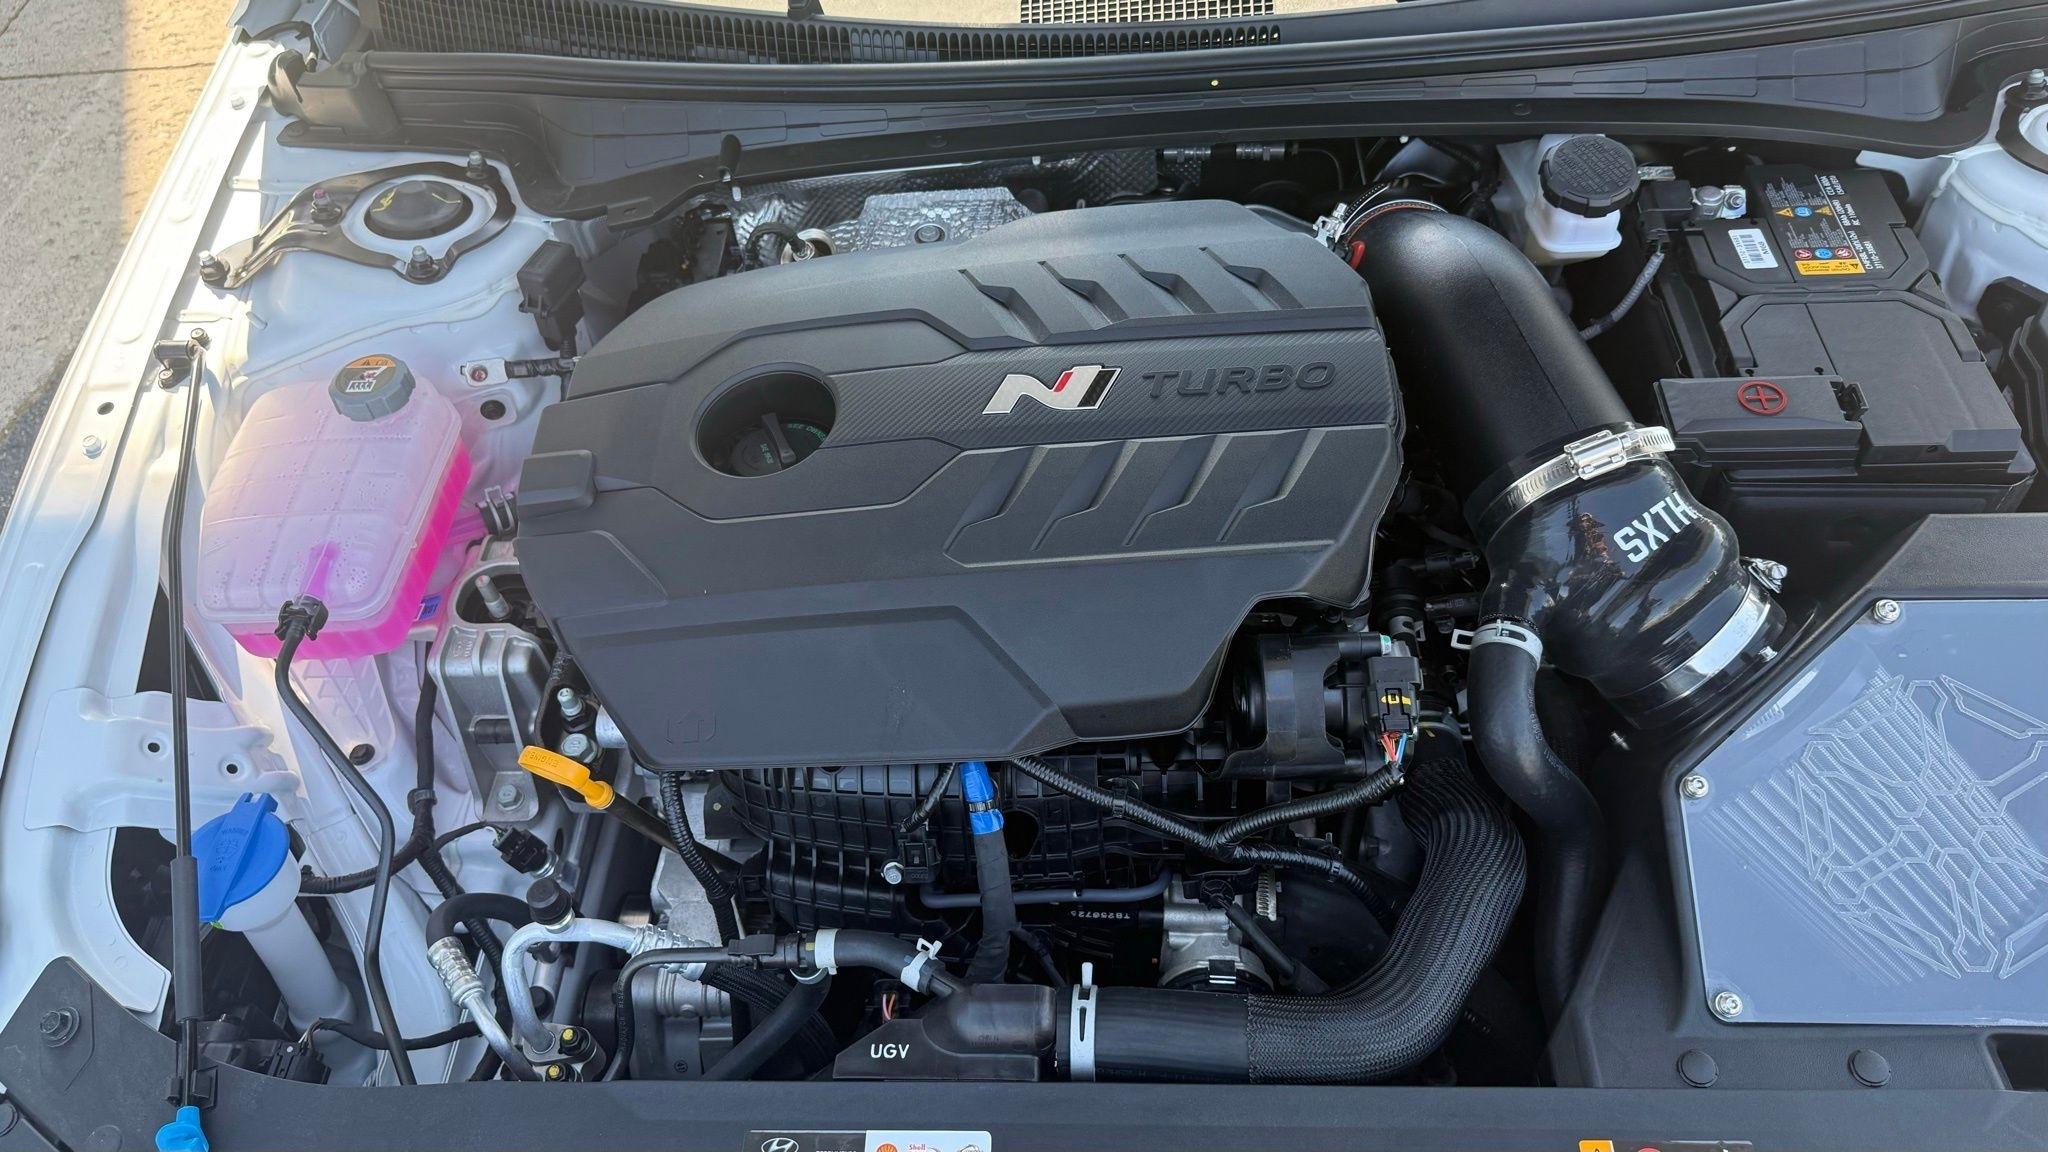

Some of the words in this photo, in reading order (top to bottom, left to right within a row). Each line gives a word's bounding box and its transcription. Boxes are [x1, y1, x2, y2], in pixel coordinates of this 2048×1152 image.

[1142, 361, 1337, 398] TURBO
[1613, 491, 1698, 563] SXTH
[870, 1043, 910, 1059] UGV
[908, 1143, 926, 1151] Shell
